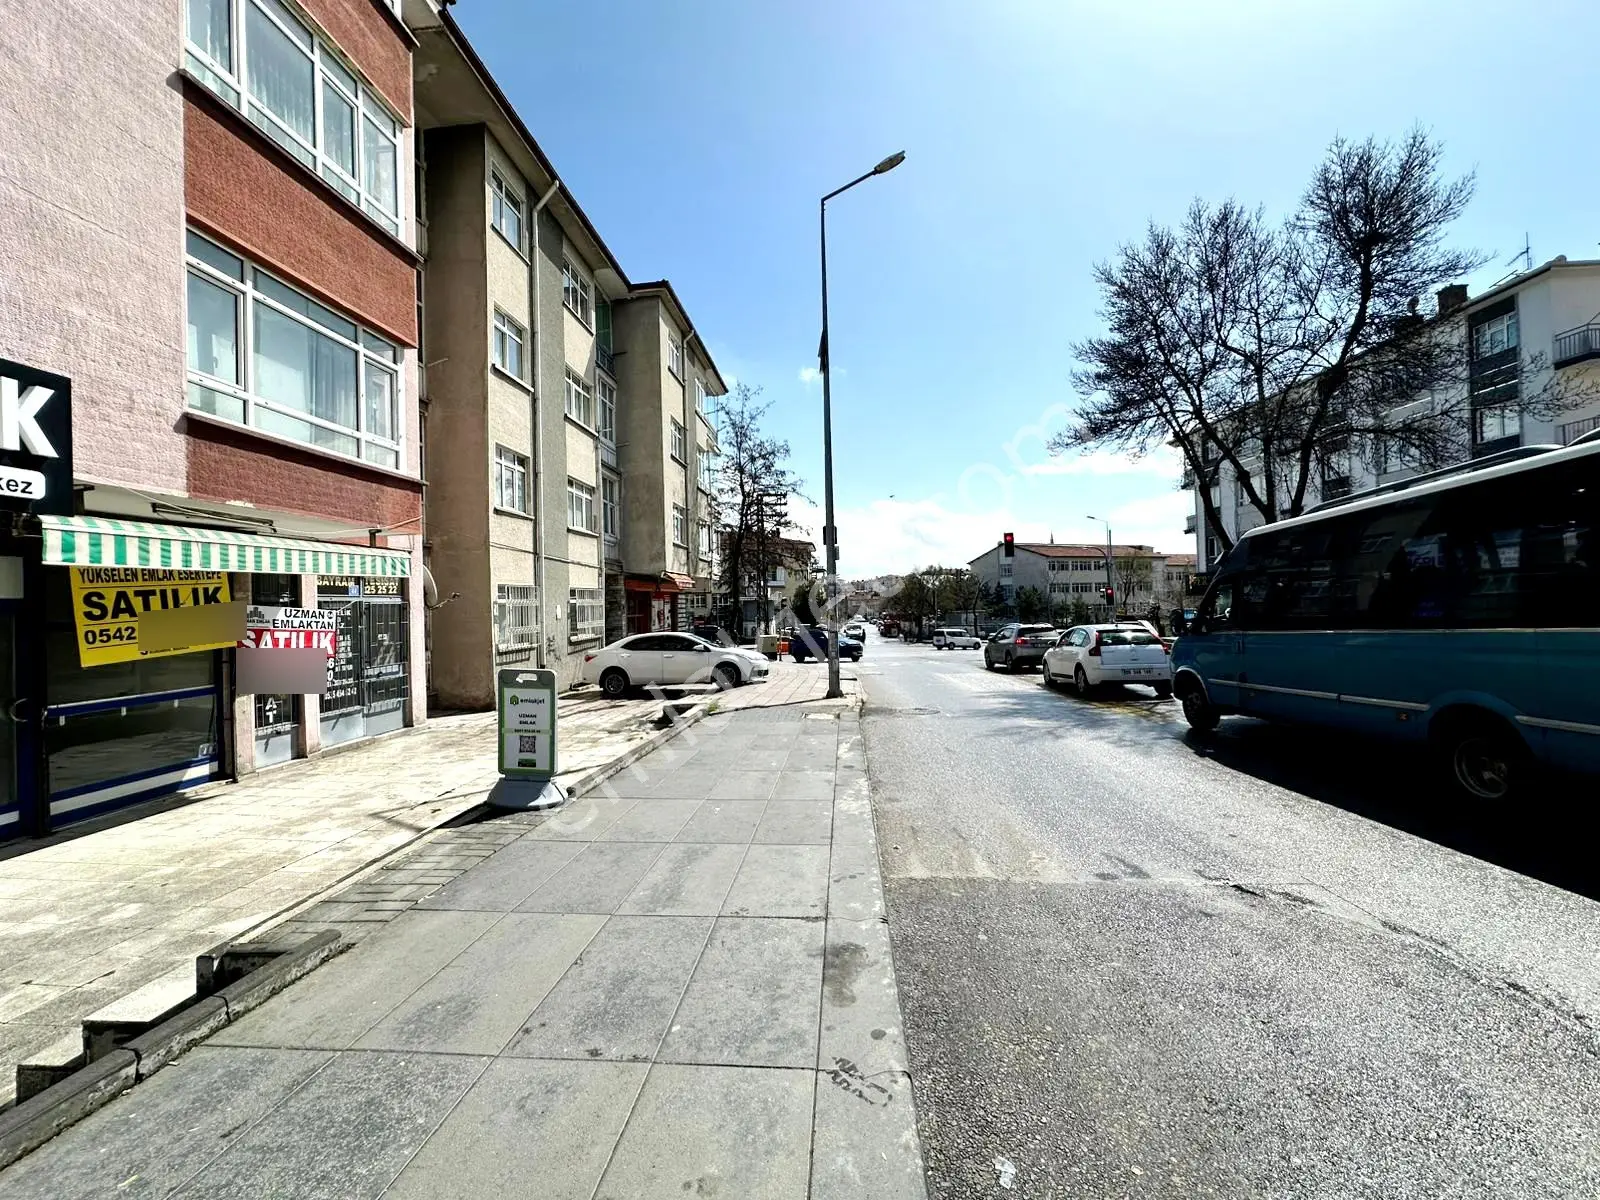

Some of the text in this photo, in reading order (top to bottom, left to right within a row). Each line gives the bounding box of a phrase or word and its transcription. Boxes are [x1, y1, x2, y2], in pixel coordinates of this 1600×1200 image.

[141, 569, 175, 582] EMLAK
[284, 608, 325, 619] UZMAN
[272, 618, 334, 630] EMLAKTAN
[84, 626, 137, 645] 0542
